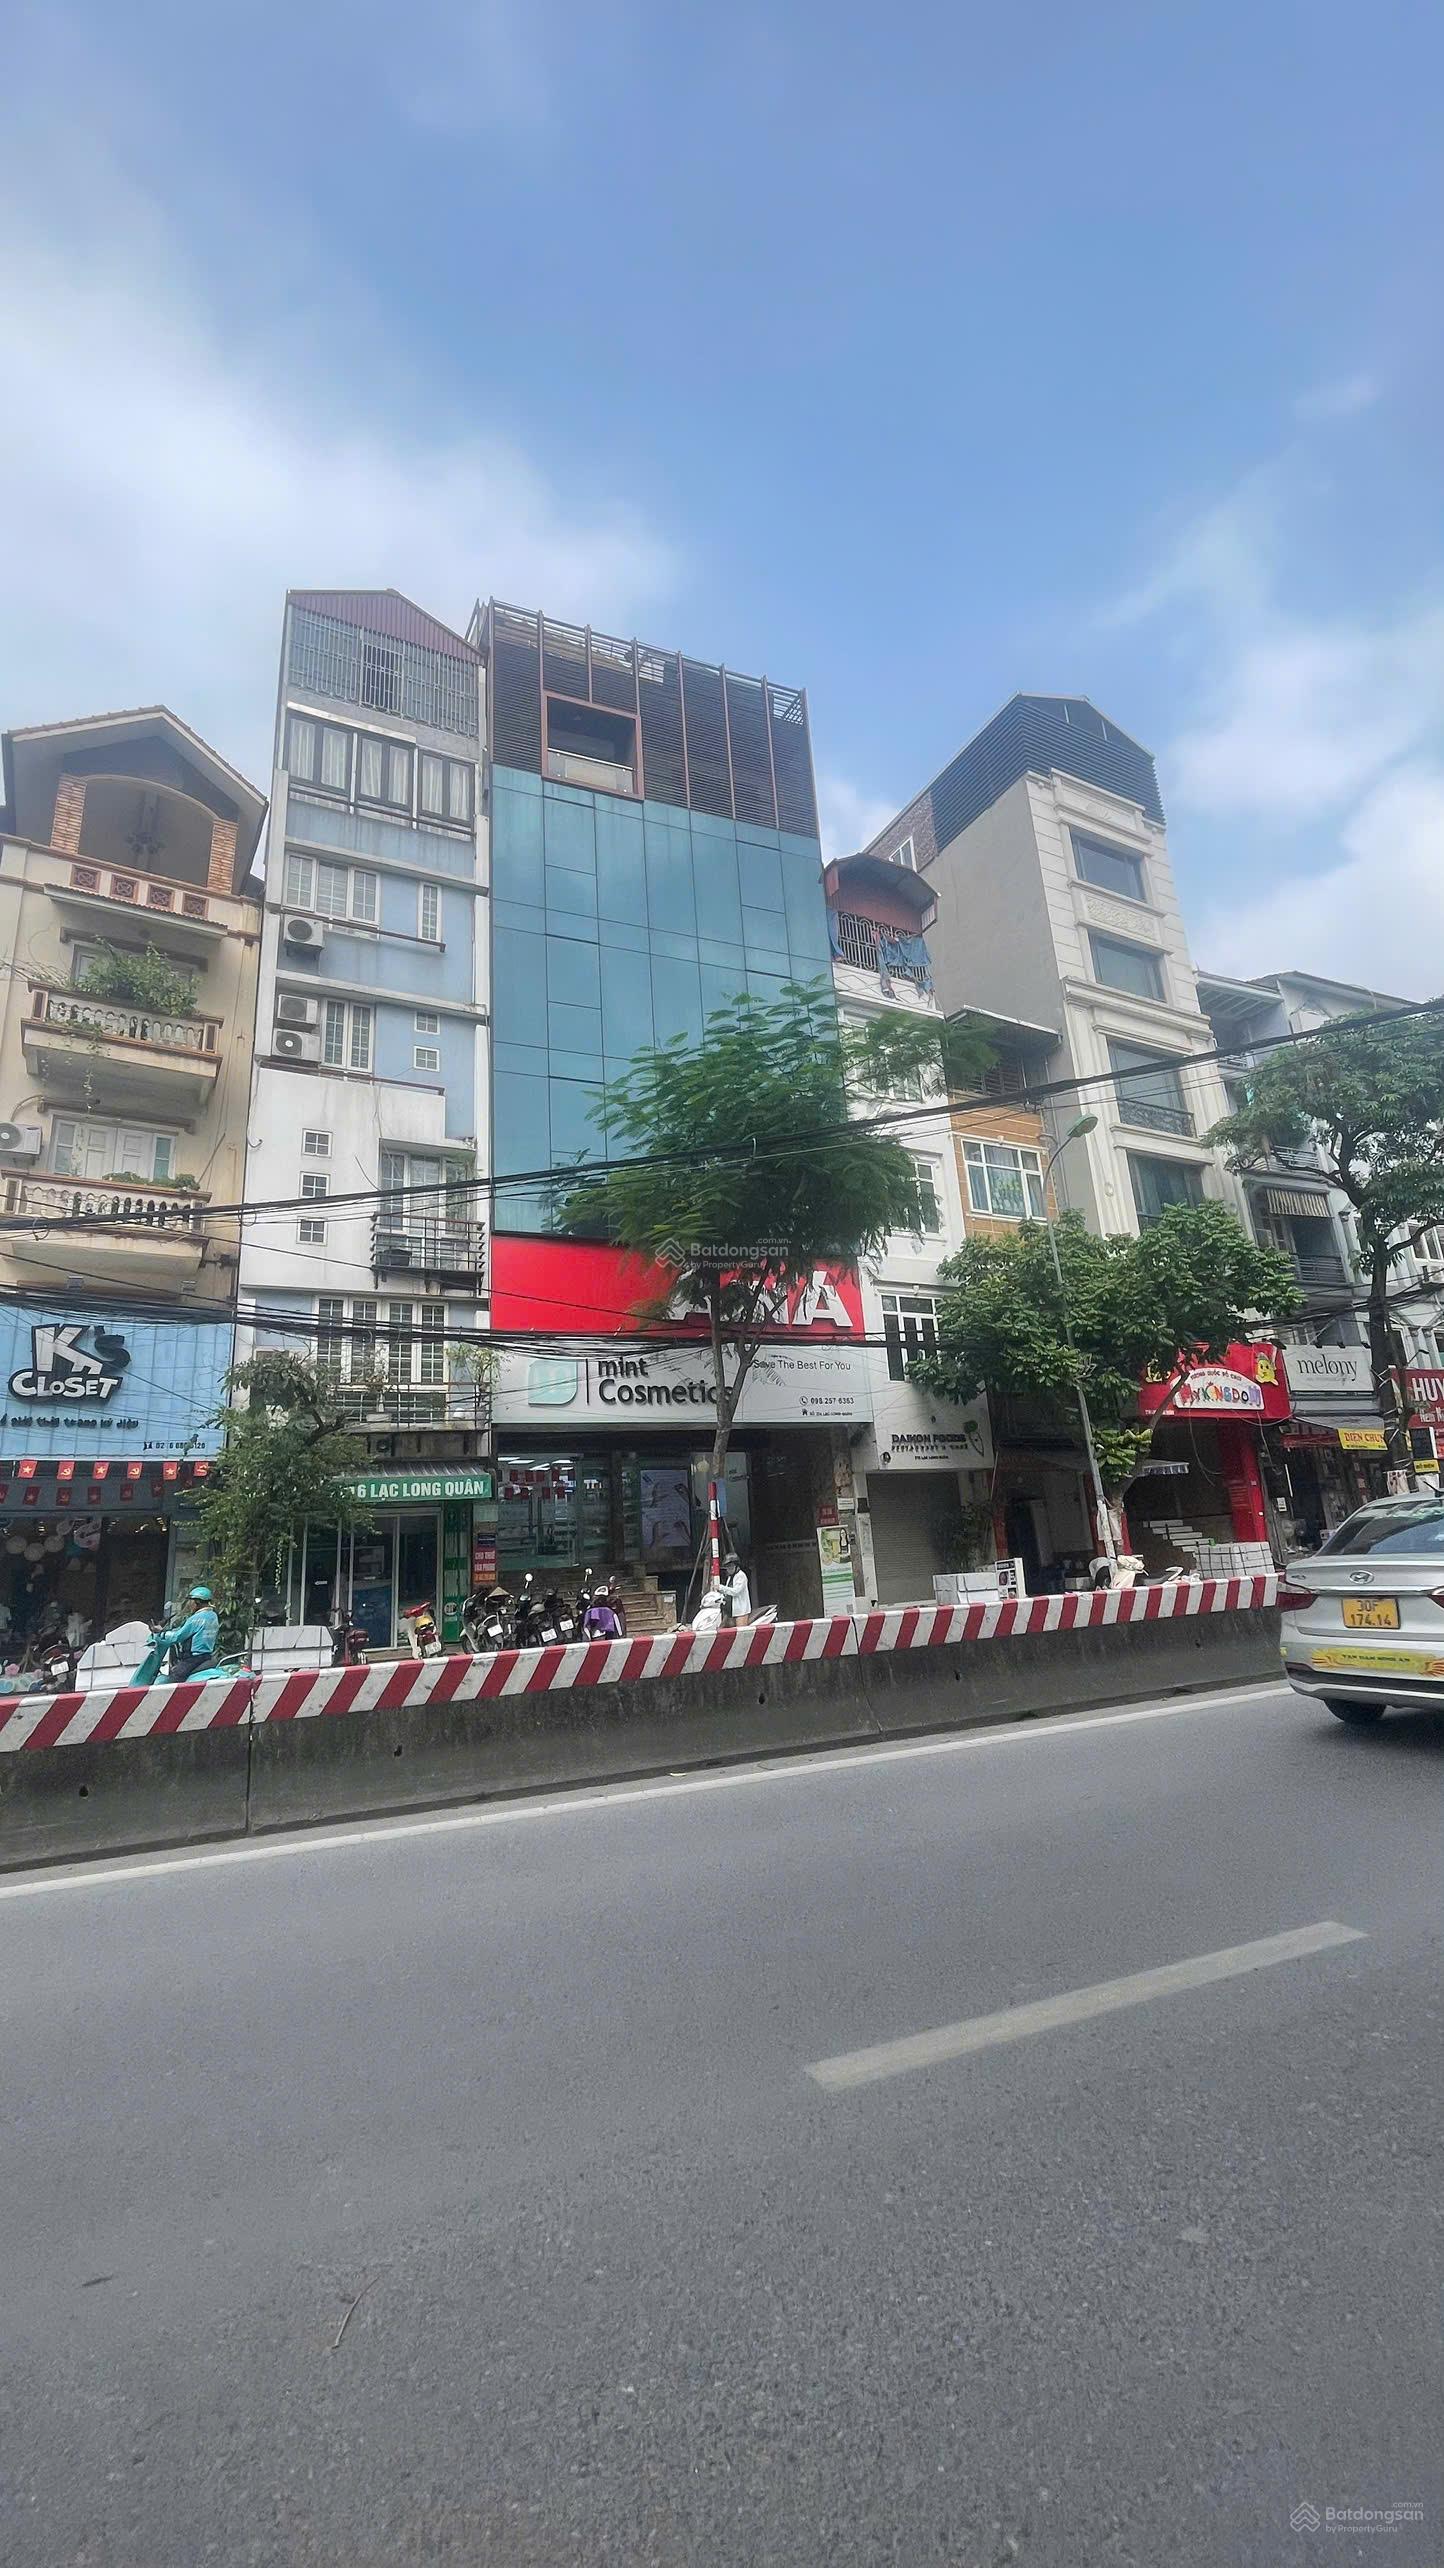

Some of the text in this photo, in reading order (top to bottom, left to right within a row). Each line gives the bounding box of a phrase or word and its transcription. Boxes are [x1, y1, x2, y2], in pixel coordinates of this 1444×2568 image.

[599, 1357, 648, 1377] mint
[778, 1360, 795, 1370] The
[797, 1361, 817, 1370] Best
[819, 1361, 834, 1370] For
[835, 1361, 851, 1371] You
[1297, 1354, 1357, 1381] melony
[892, 1434, 931, 1443] DAIKON
[370, 1484, 399, 1500] LẠC
[402, 1482, 441, 1497] LONG
[444, 1479, 484, 1496] QUÂN
[1357, 1600, 1378, 1612] 30F
